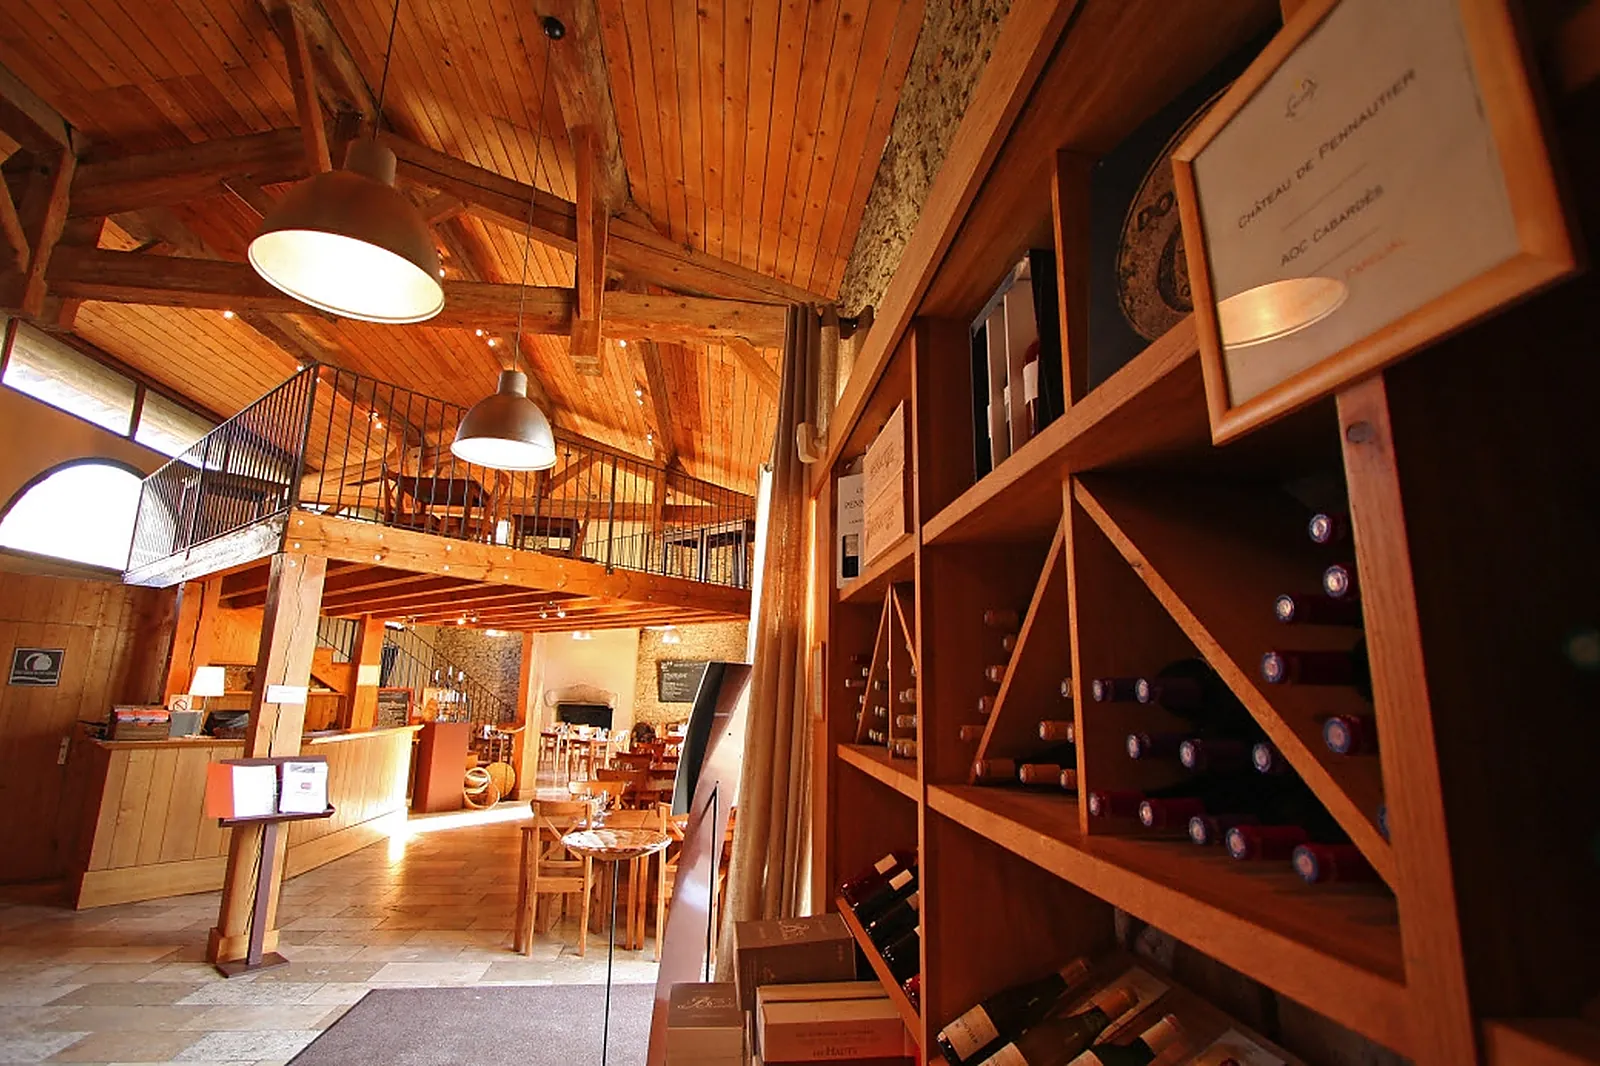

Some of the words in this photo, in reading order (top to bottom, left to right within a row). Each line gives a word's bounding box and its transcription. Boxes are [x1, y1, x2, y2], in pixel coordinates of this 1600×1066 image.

[1238, 179, 1291, 228] CHÂTEAU
[1296, 159, 1314, 180] DE
[1318, 68, 1416, 159] PENNAUTIER
[1281, 239, 1309, 266] AOC
